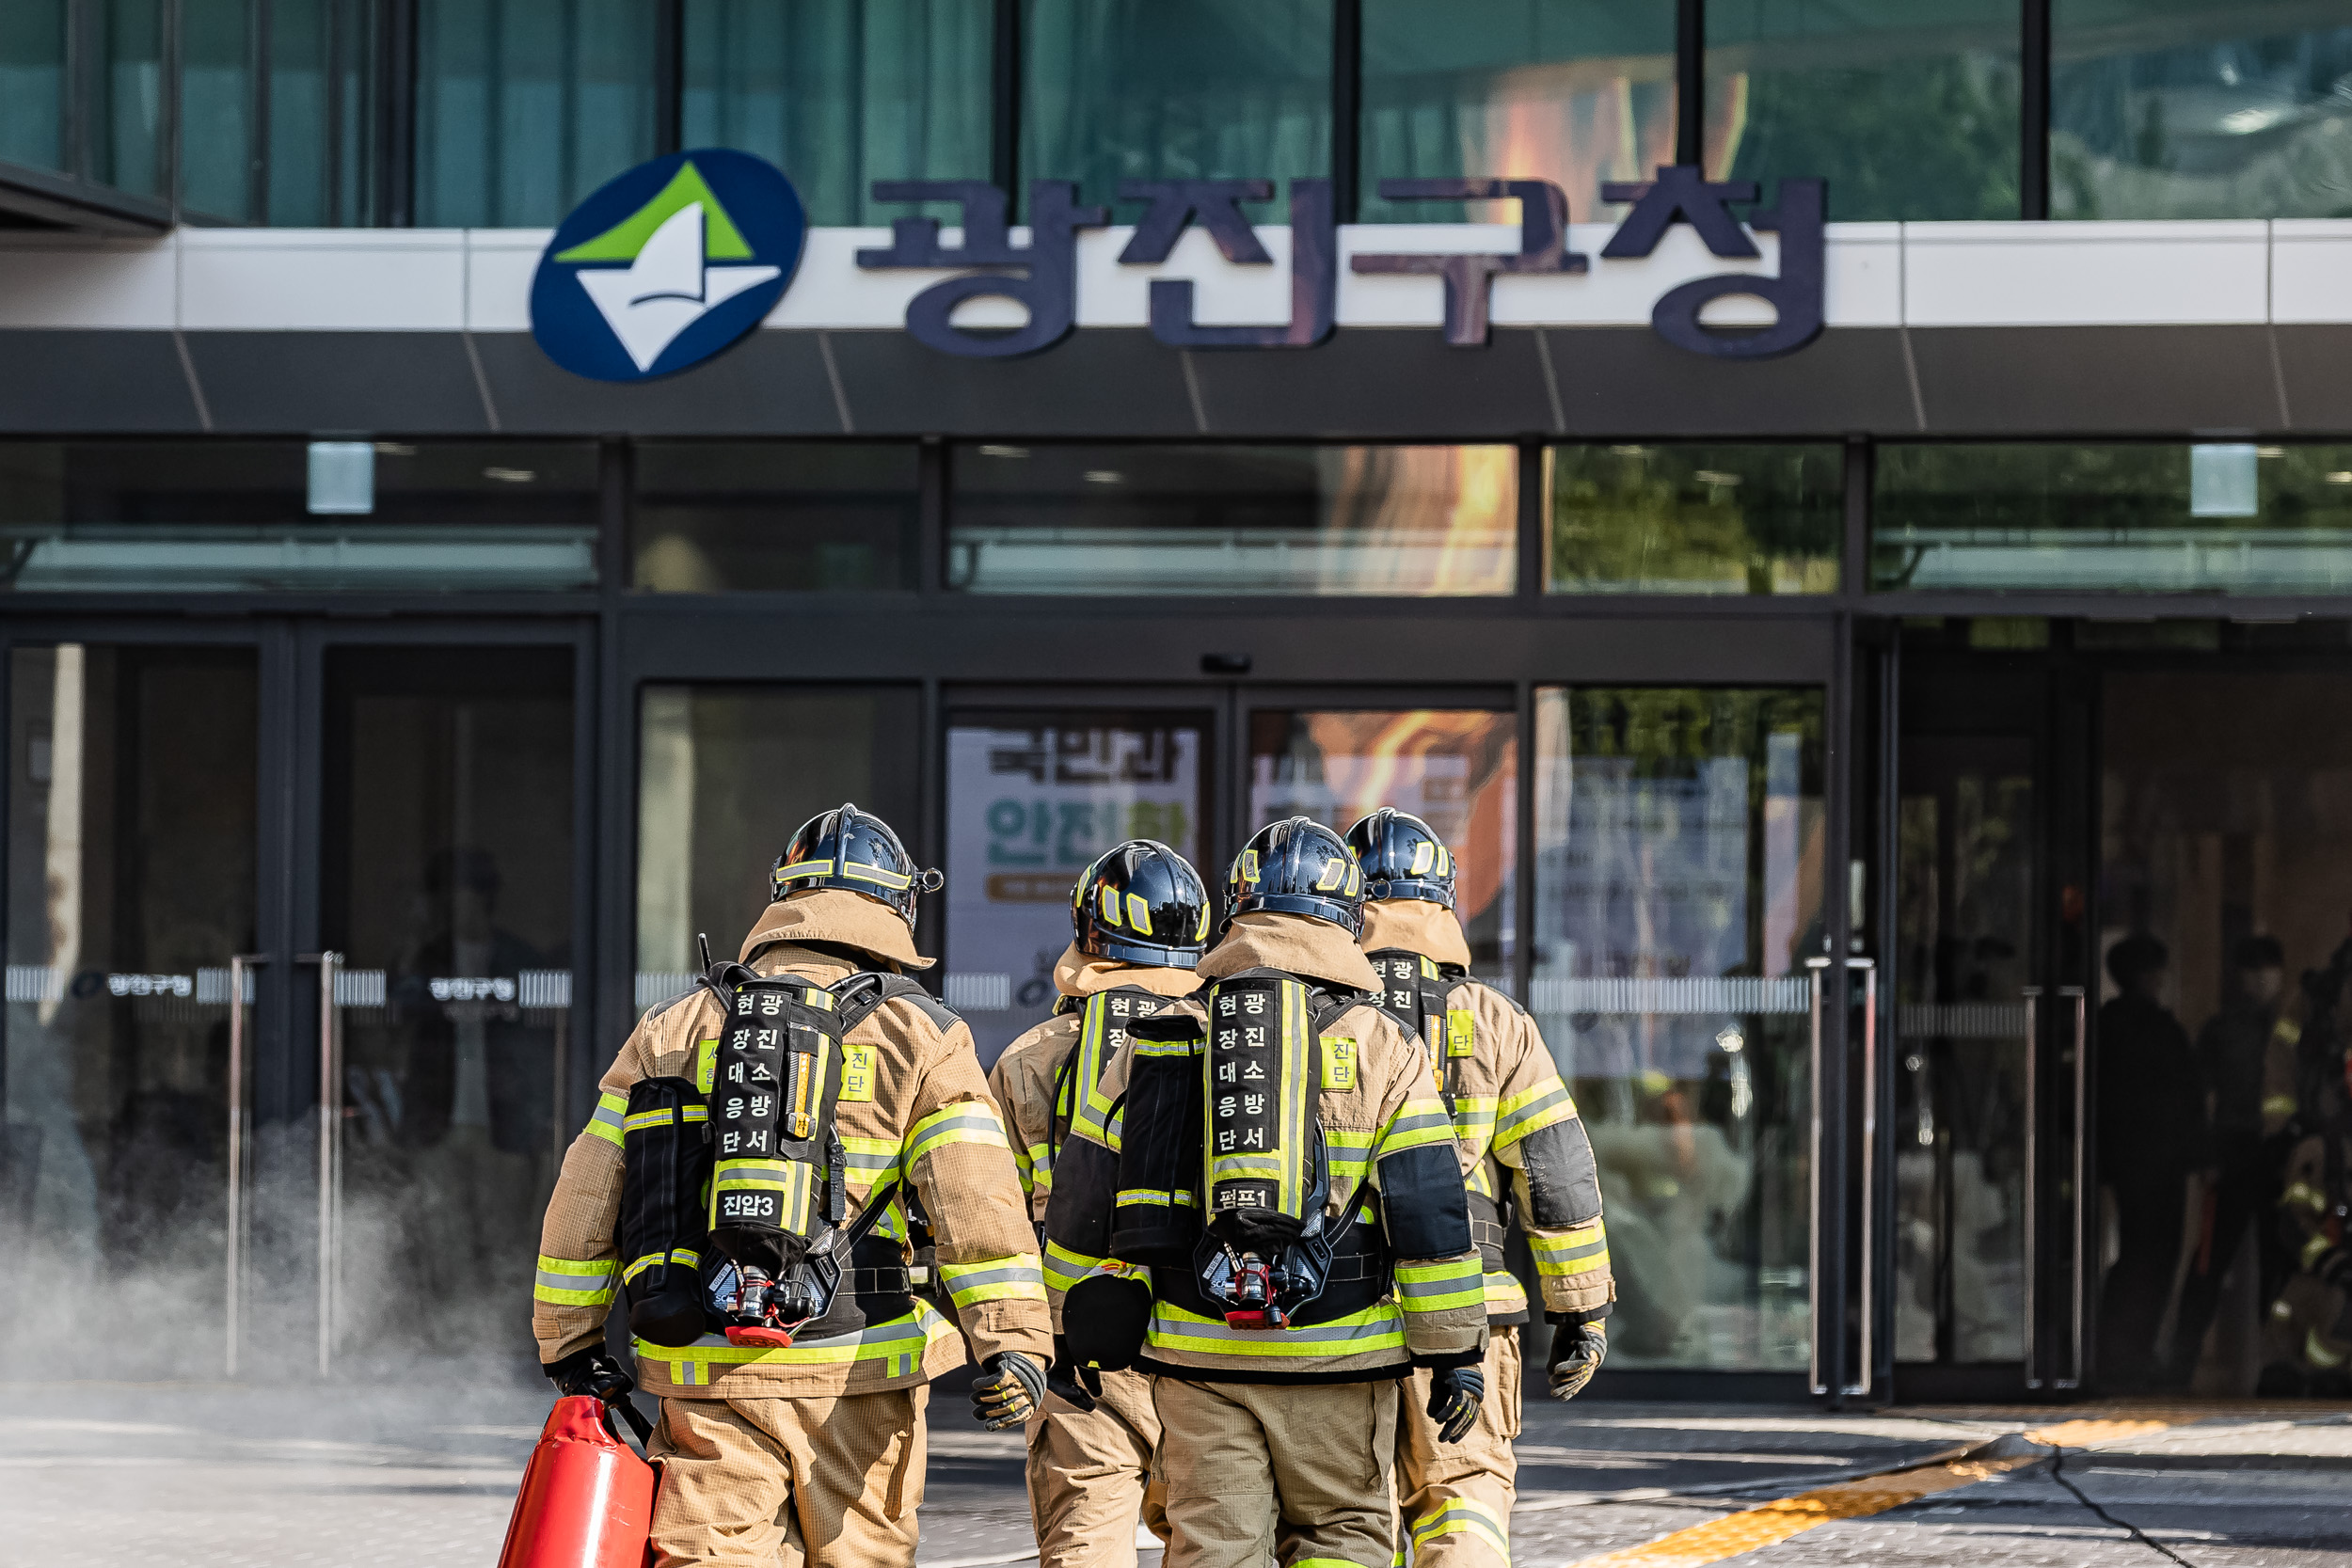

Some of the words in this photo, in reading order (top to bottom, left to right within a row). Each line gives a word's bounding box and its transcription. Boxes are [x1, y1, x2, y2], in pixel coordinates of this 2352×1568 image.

[855, 165, 1827, 357] 광진구청
[723, 1195, 773, 1216] 진압3
[1219, 1188, 1266, 1210] 펌프1
